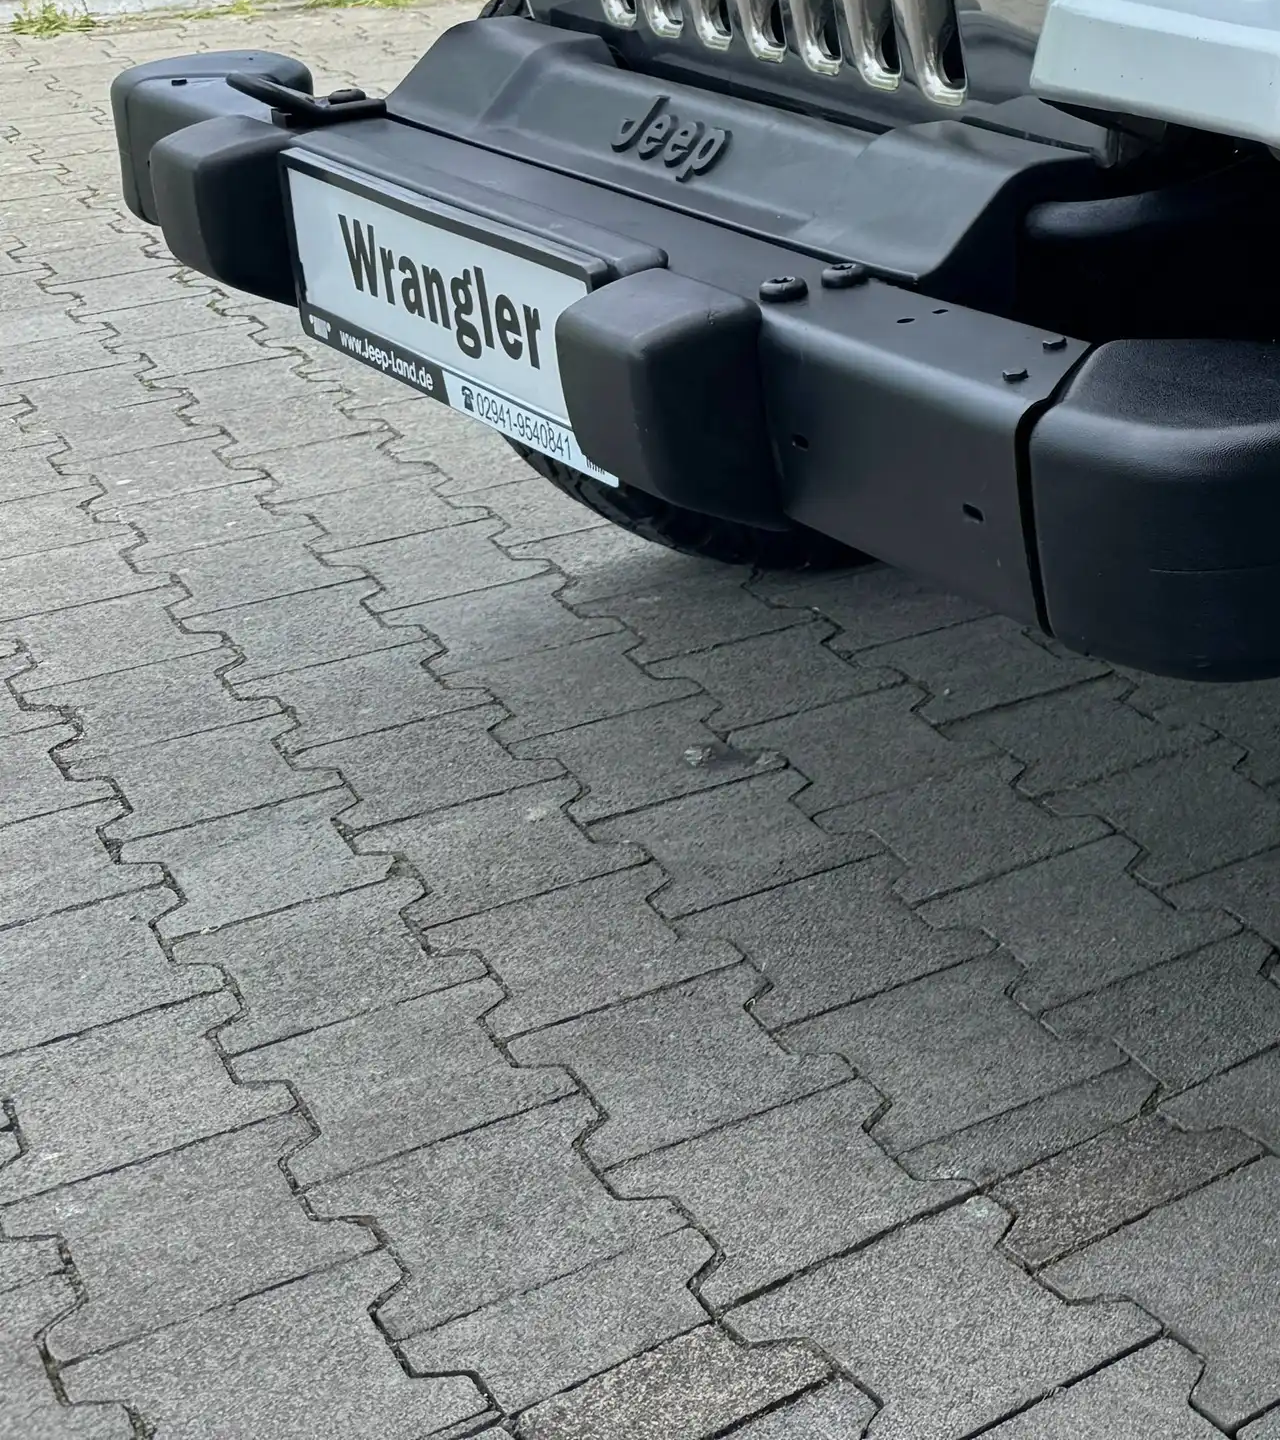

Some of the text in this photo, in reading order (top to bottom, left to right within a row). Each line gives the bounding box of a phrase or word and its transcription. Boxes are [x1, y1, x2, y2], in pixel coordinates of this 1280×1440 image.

[610, 94, 733, 183] Jeep
[338, 213, 541, 370] Wrangler
[340, 329, 433, 391] www.Jeep-Land.de
[476, 392, 572, 461] 02941-9540841
